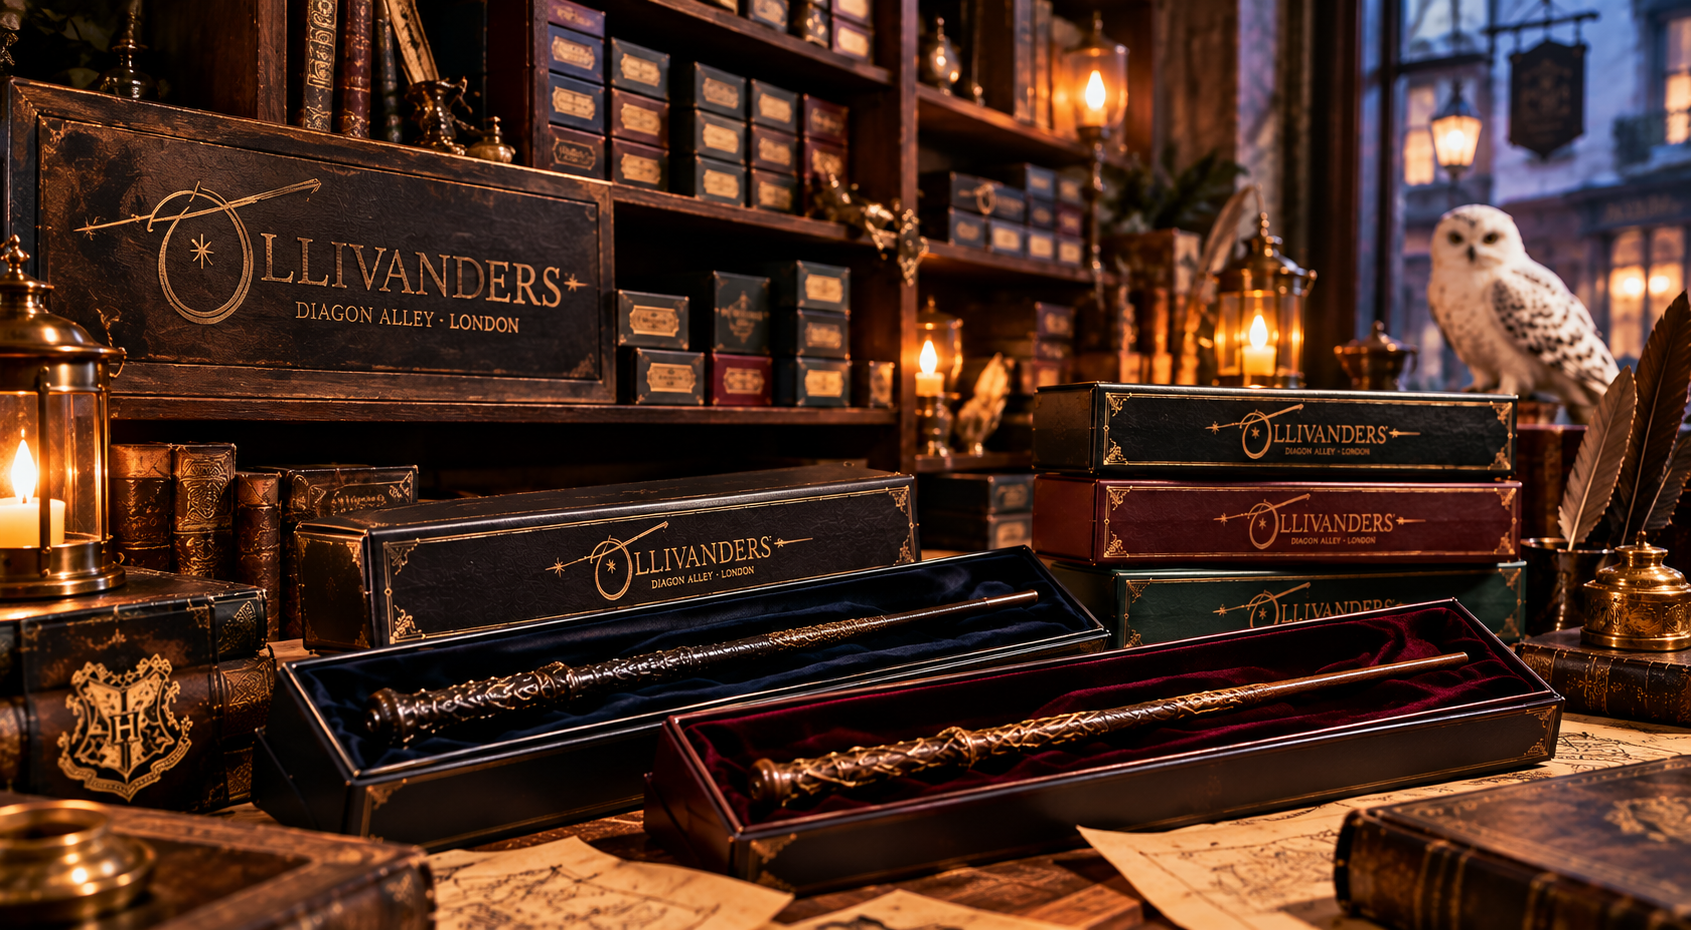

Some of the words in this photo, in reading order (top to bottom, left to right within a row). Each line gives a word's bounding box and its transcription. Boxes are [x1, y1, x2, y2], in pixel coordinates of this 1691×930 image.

[148, 181, 561, 324] OLLIVANDERS
[294, 301, 373, 323] DIAGON
[379, 308, 435, 327] ALLEY
[449, 313, 519, 333] LONDON
[1320, 537, 1341, 545] ALLEY
[651, 576, 685, 589] DIAGON
[687, 571, 713, 583] ALLEY
[721, 565, 755, 578] LONDON
[113, 713, 140, 743] H
